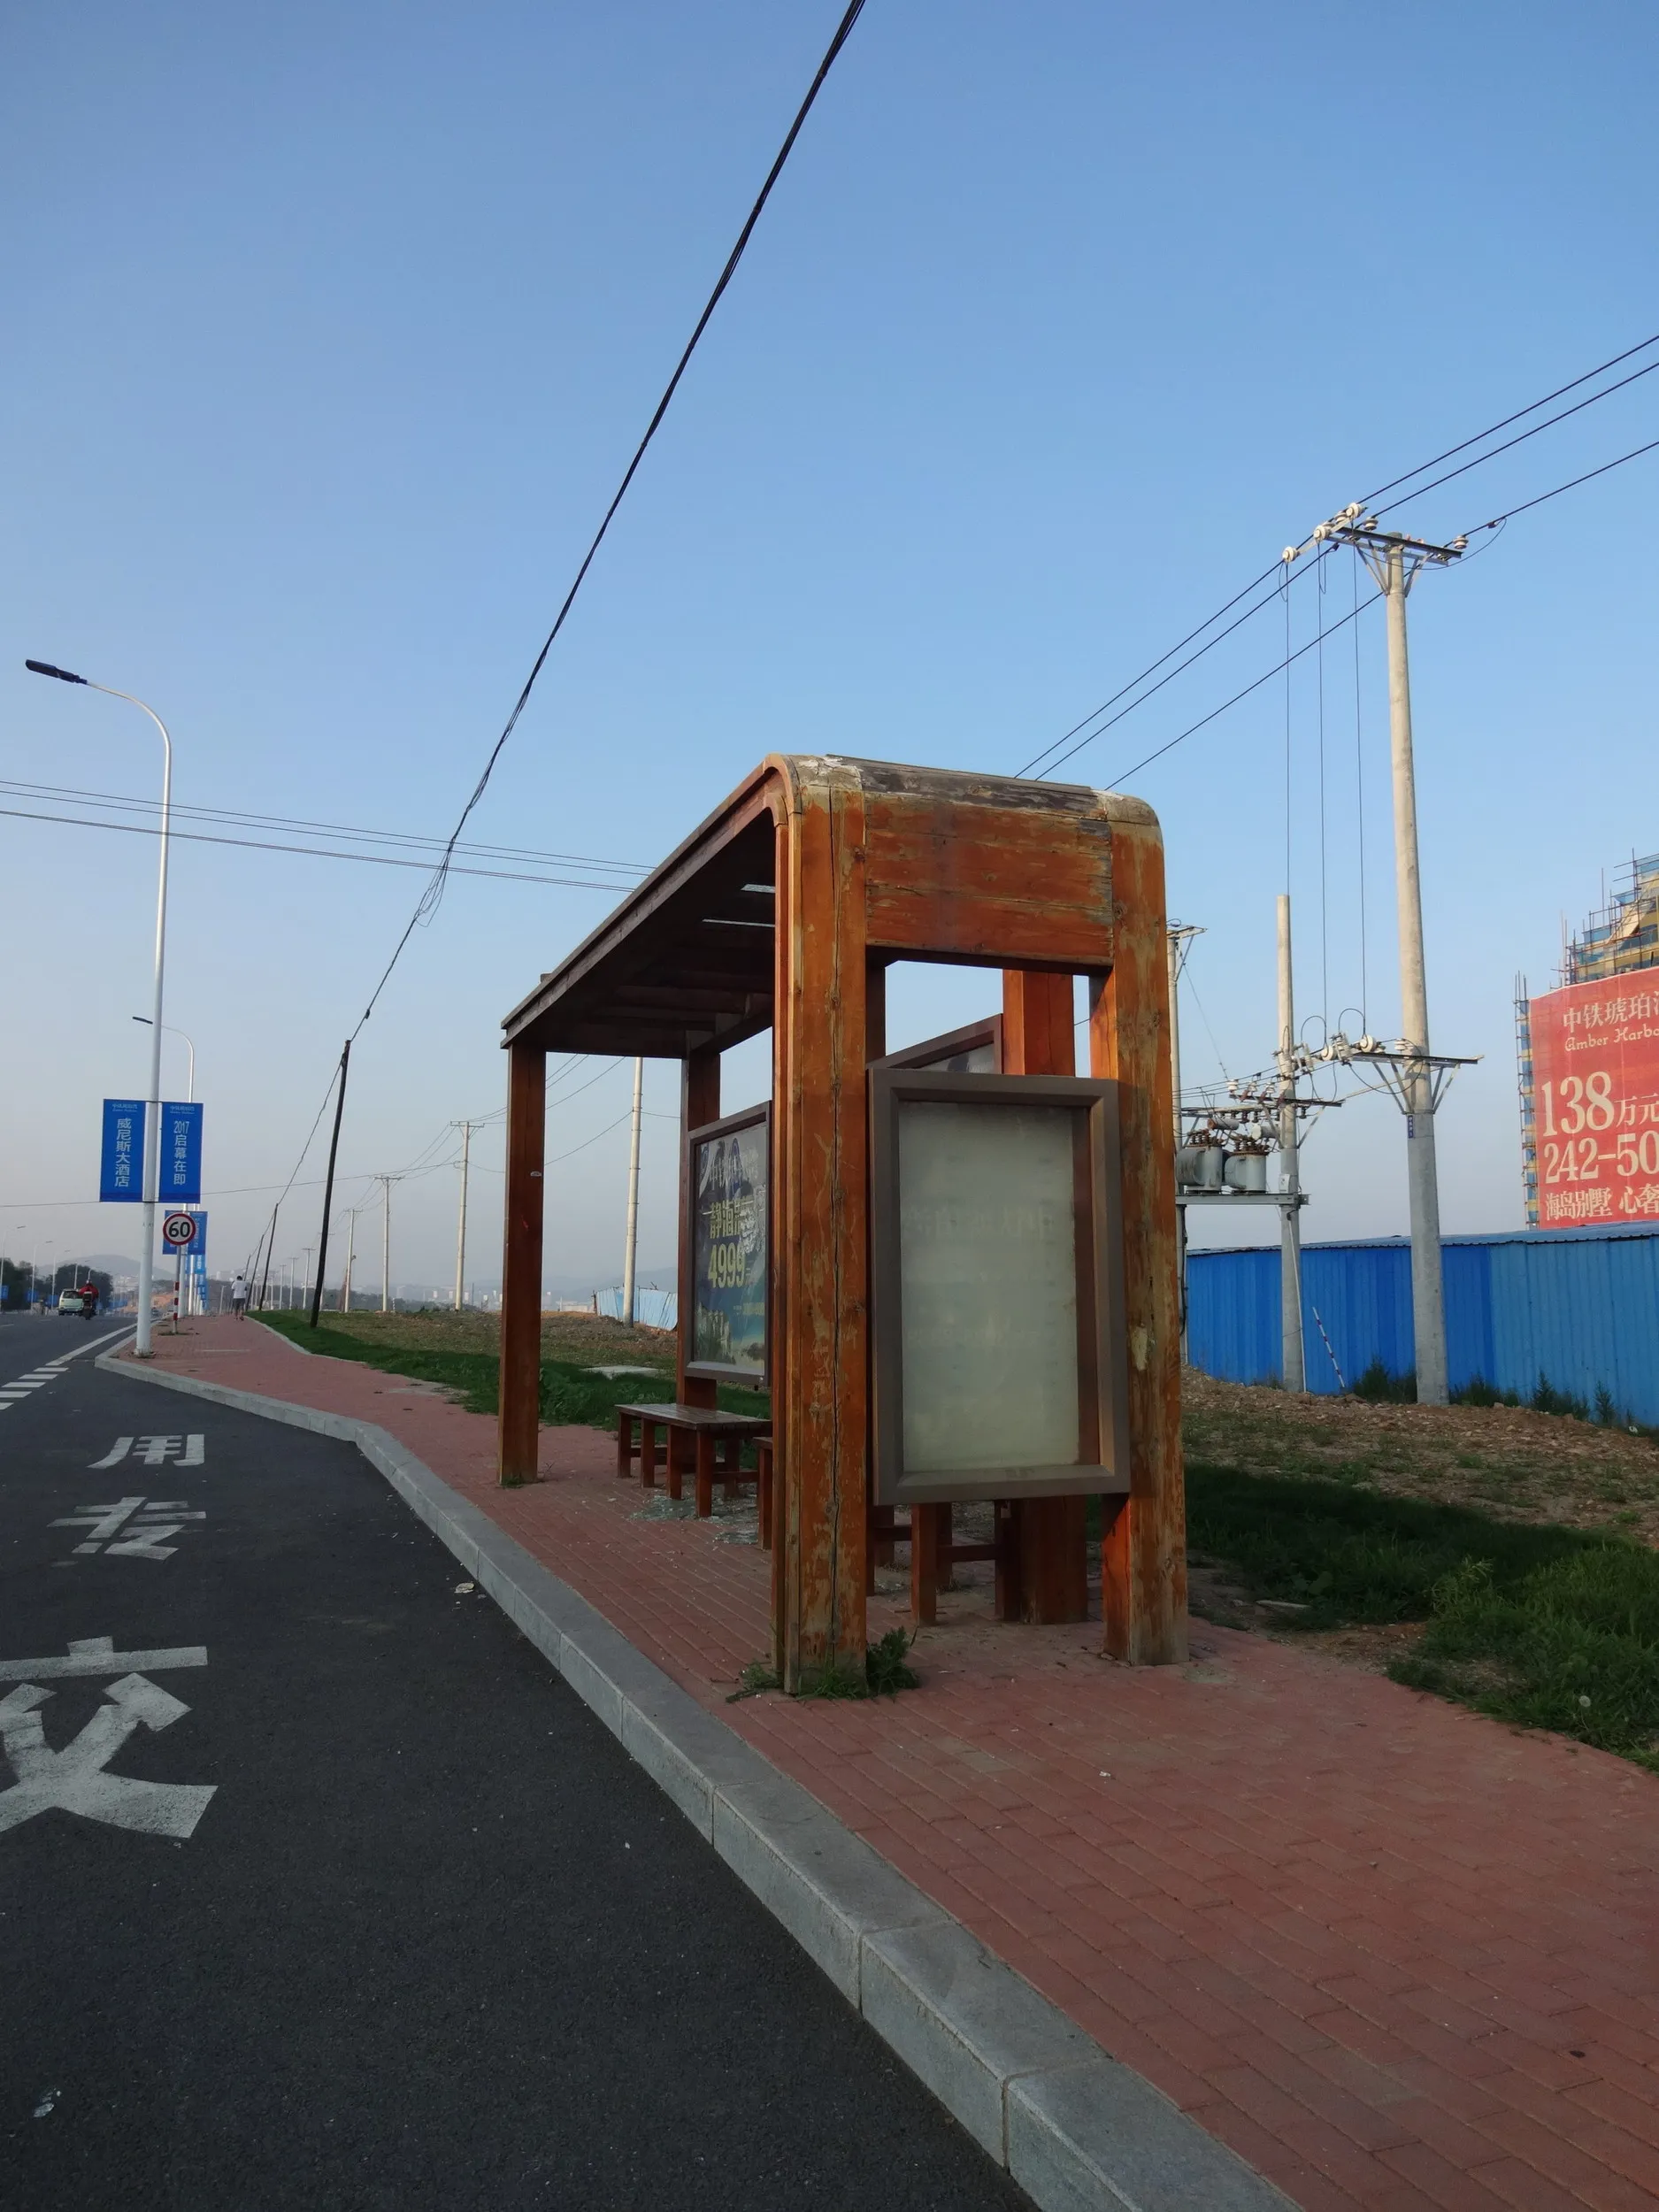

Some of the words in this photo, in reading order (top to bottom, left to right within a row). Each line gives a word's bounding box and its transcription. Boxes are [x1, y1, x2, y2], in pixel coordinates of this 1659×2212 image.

[1565, 1033, 1609, 1051] Amber
[114, 1118, 132, 1187] 威尼斯大酒店
[168, 1221, 190, 1238] 60
